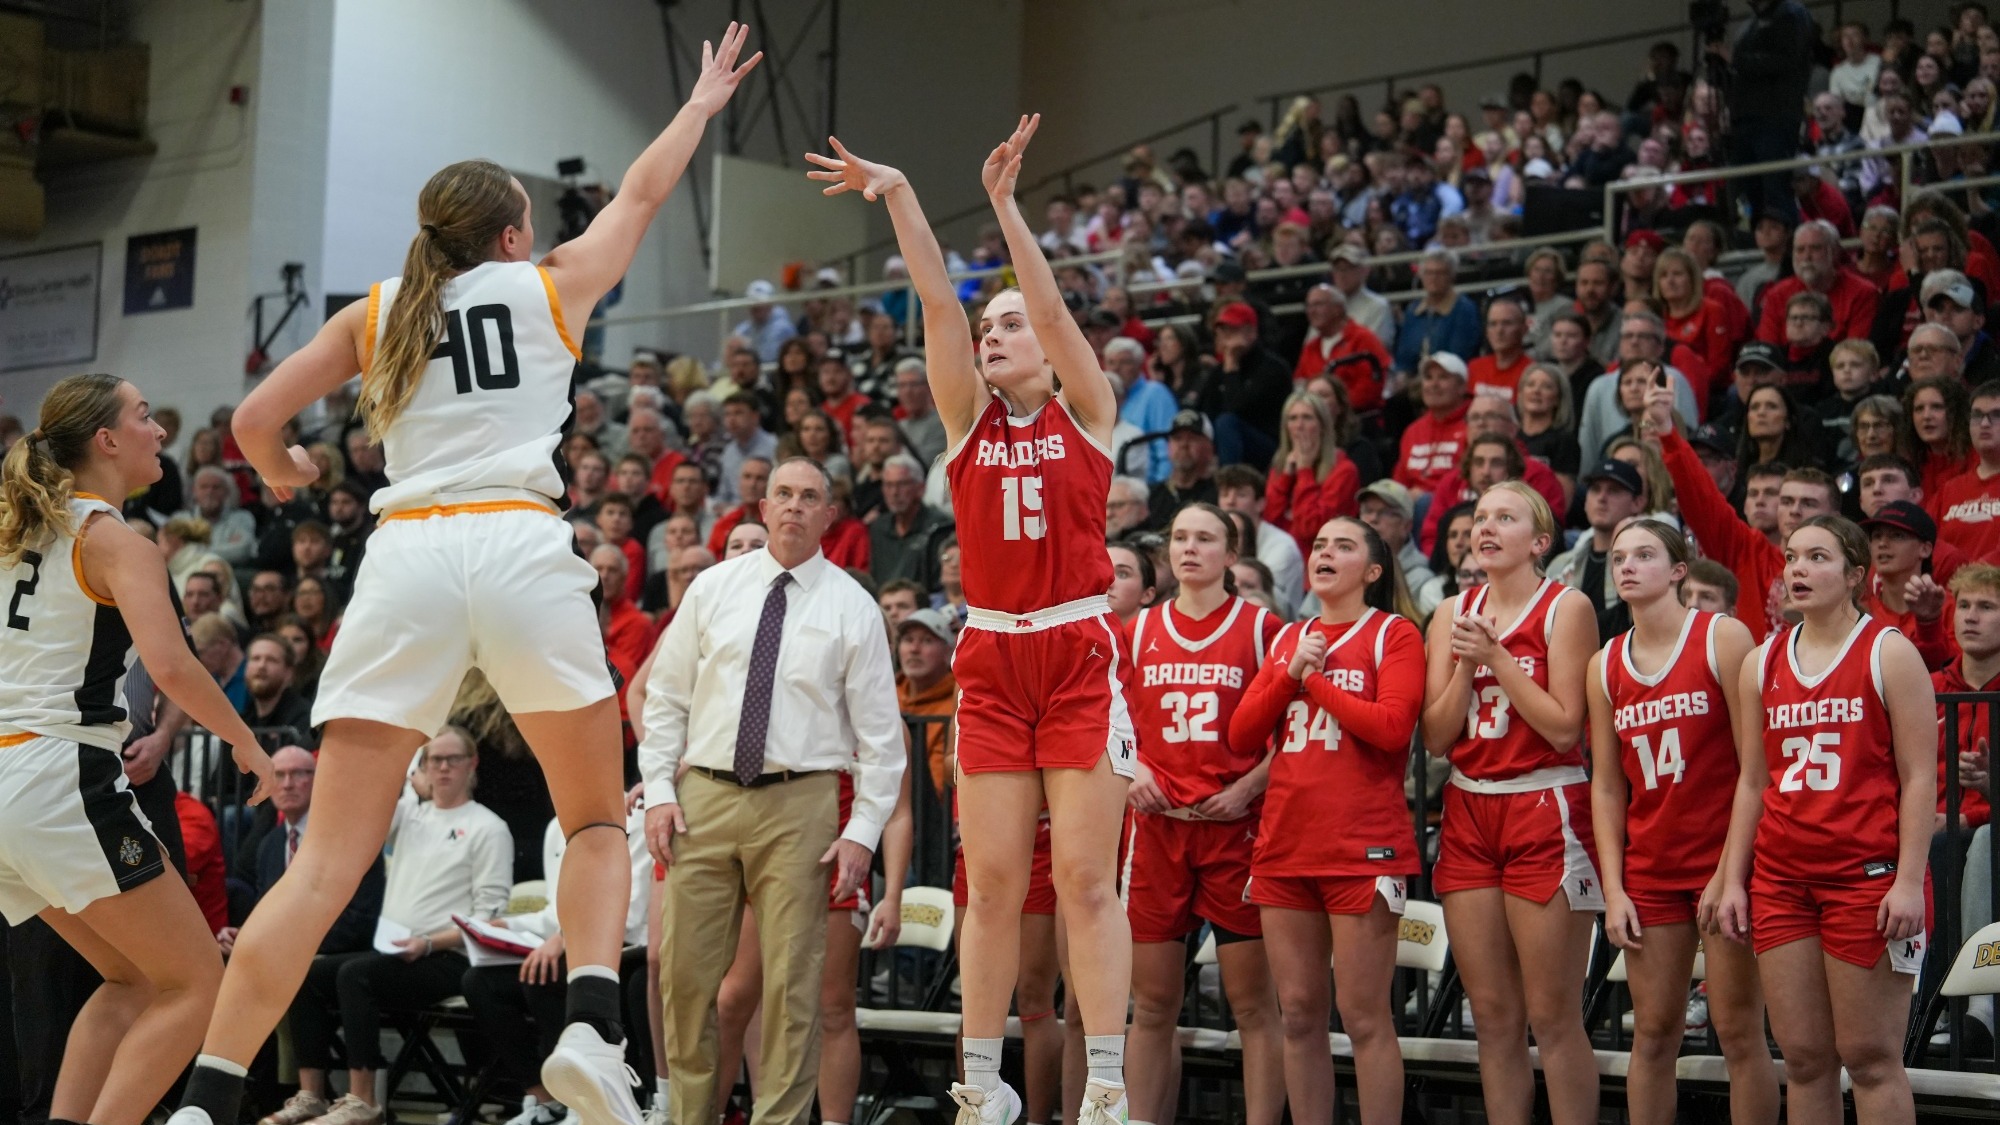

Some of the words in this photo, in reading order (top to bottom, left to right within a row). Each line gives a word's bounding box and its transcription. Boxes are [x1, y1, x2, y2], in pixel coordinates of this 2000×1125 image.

[425, 304, 520, 394] 40
[1002, 476, 1047, 541] 15
[7, 549, 43, 631] 2
[1143, 663, 1243, 689] RAIDERS
[1160, 691, 1219, 743] 32
[1282, 700, 1342, 753] 34
[1614, 690, 1709, 733] RAIDERS
[1631, 727, 1686, 791] 14
[1779, 732, 1841, 793] 25
